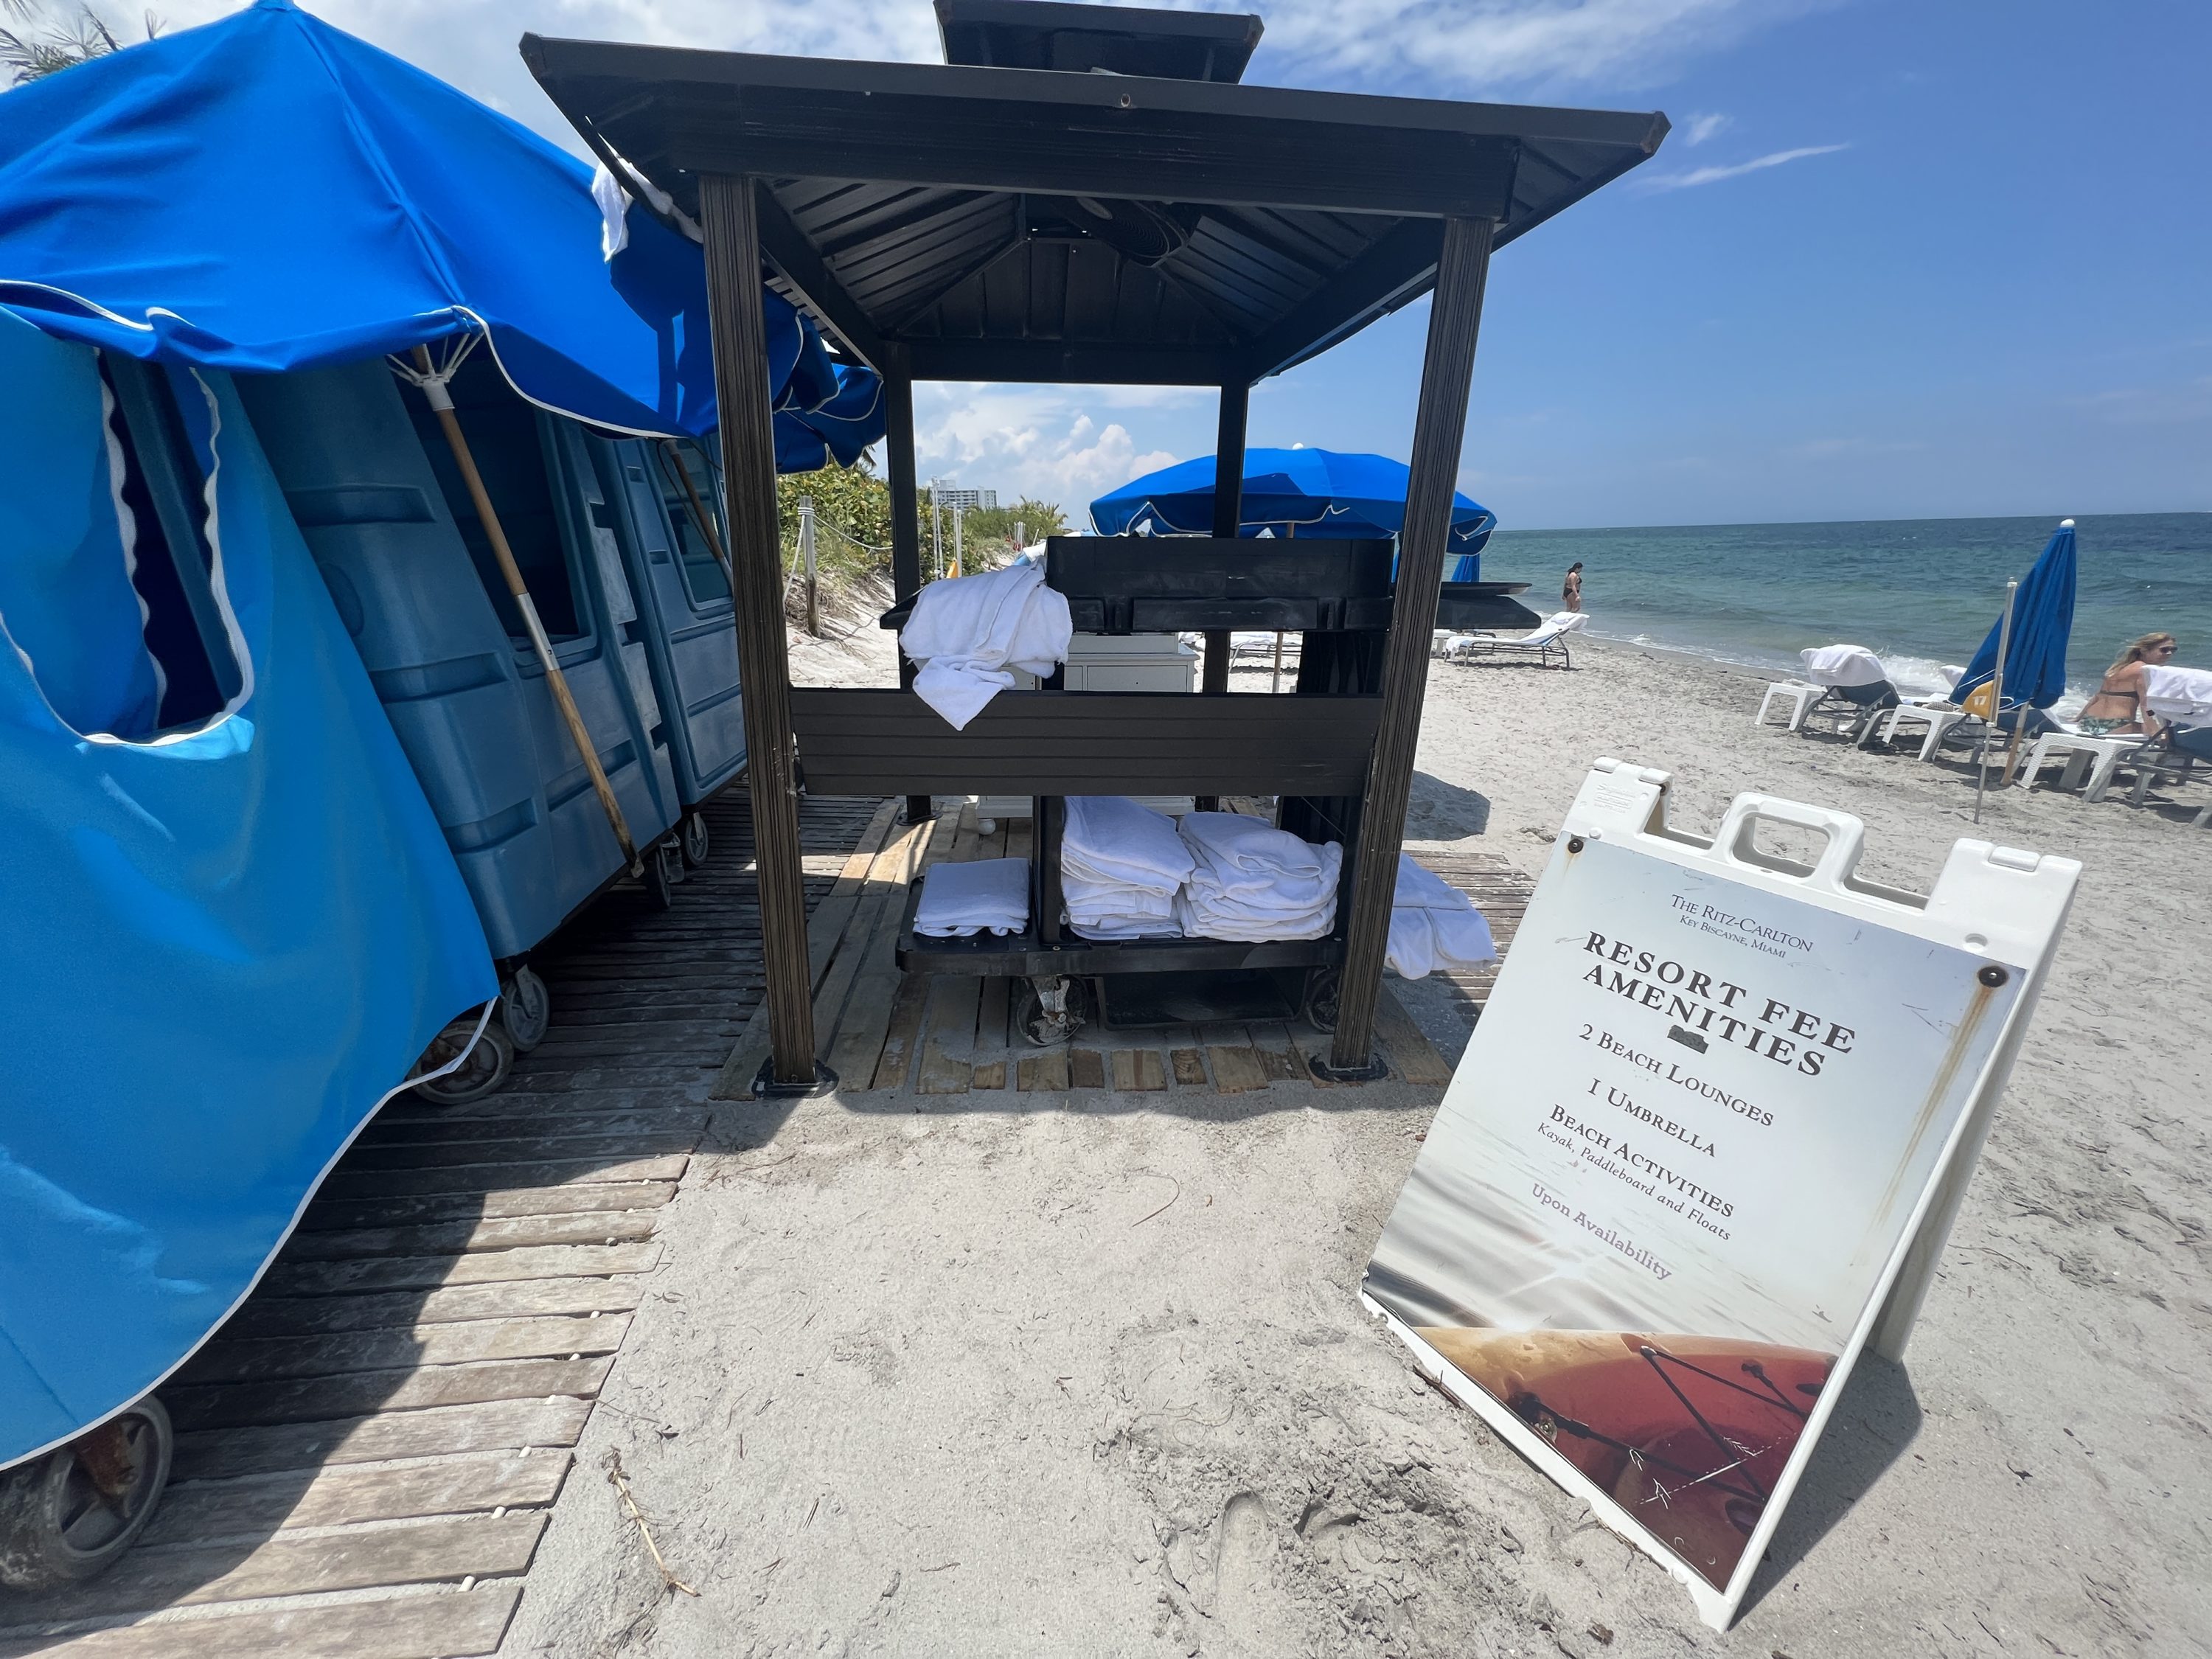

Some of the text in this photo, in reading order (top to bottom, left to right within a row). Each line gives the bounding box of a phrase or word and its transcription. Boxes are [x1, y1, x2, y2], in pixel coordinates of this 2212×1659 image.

[1672, 894, 1814, 952] THE RITZ-CARLTON
[1680, 914, 1787, 959] KEY BISCAYNE, MIAMI
[1582, 931, 1856, 1054] RESORT FEE
[1582, 964, 1826, 1077] AMENITIES
[1579, 1023, 1775, 1127] 2 BEACH LOUNGES
[1607, 1086, 1717, 1158] UMBRELLA
[1537, 1121, 1731, 1241] Kayak, Paddleboard and Floats
[1549, 1104, 1734, 1217] BEACH ACTIVITIES
[1532, 1183, 1673, 1281] Upon Availability
